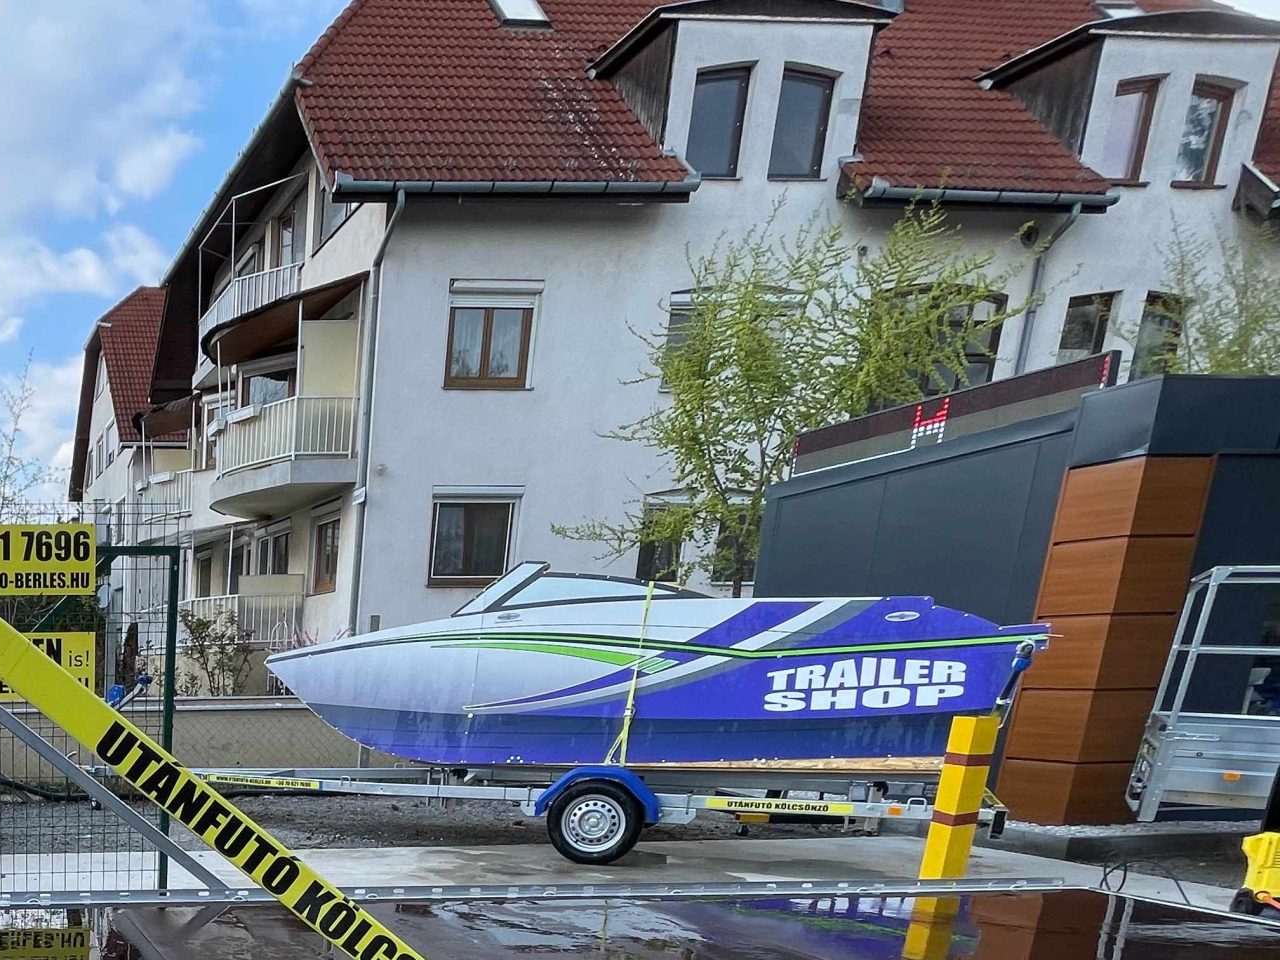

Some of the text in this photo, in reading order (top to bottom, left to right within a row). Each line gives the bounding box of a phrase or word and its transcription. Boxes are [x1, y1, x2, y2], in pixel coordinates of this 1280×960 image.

[21, 530, 90, 562] 7696
[69, 650, 89, 667] is!
[766, 657, 967, 690] TRAILER
[764, 685, 964, 711] SHOP
[96, 720, 300, 896] UTÁNFUTÓ
[727, 800, 772, 809] UTÁNFUTÓ
